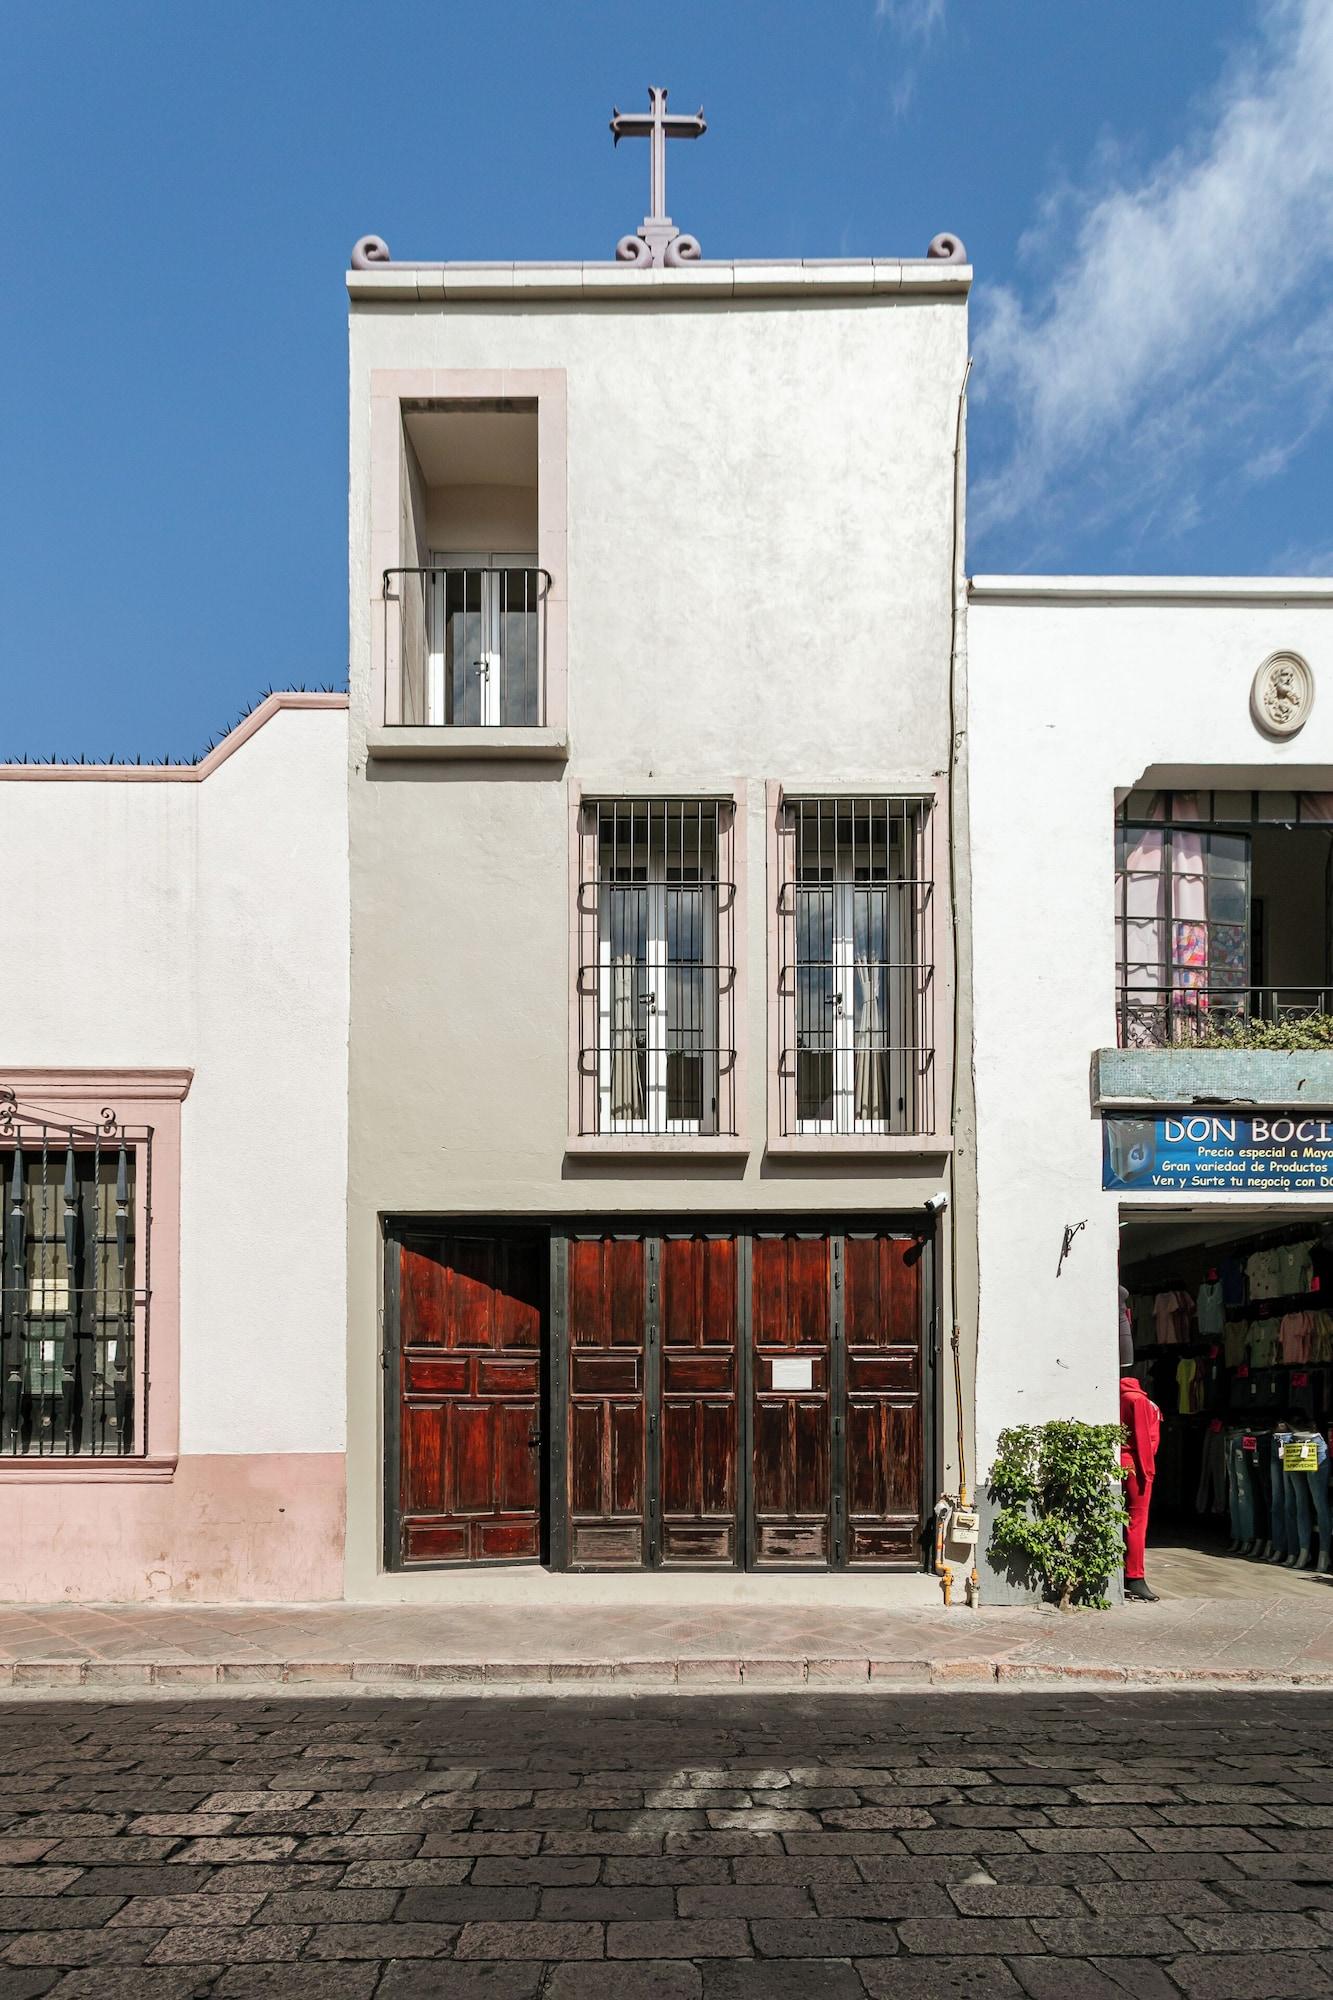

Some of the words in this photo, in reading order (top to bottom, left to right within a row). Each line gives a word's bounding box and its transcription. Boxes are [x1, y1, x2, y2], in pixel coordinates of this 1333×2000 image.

[1165, 1118, 1236, 1142] DON
[1252, 1117, 1332, 1142] BOCI
[1198, 1146, 1234, 1157] Precio
[1239, 1146, 1286, 1160] especial
[1290, 1149, 1298, 1158] a
[1162, 1160, 1191, 1171] Gran
[1195, 1161, 1246, 1172] variedad
[1250, 1161, 1265, 1172] de
[1270, 1161, 1328, 1172] Productos
[1152, 1175, 1175, 1186] Ven
[1178, 1178, 1187, 1189] y
[1191, 1175, 1226, 1186] Surte
[1230, 1176, 1243, 1186] tu
[1247, 1176, 1291, 1190] negocio
[1295, 1178, 1316, 1187] con
